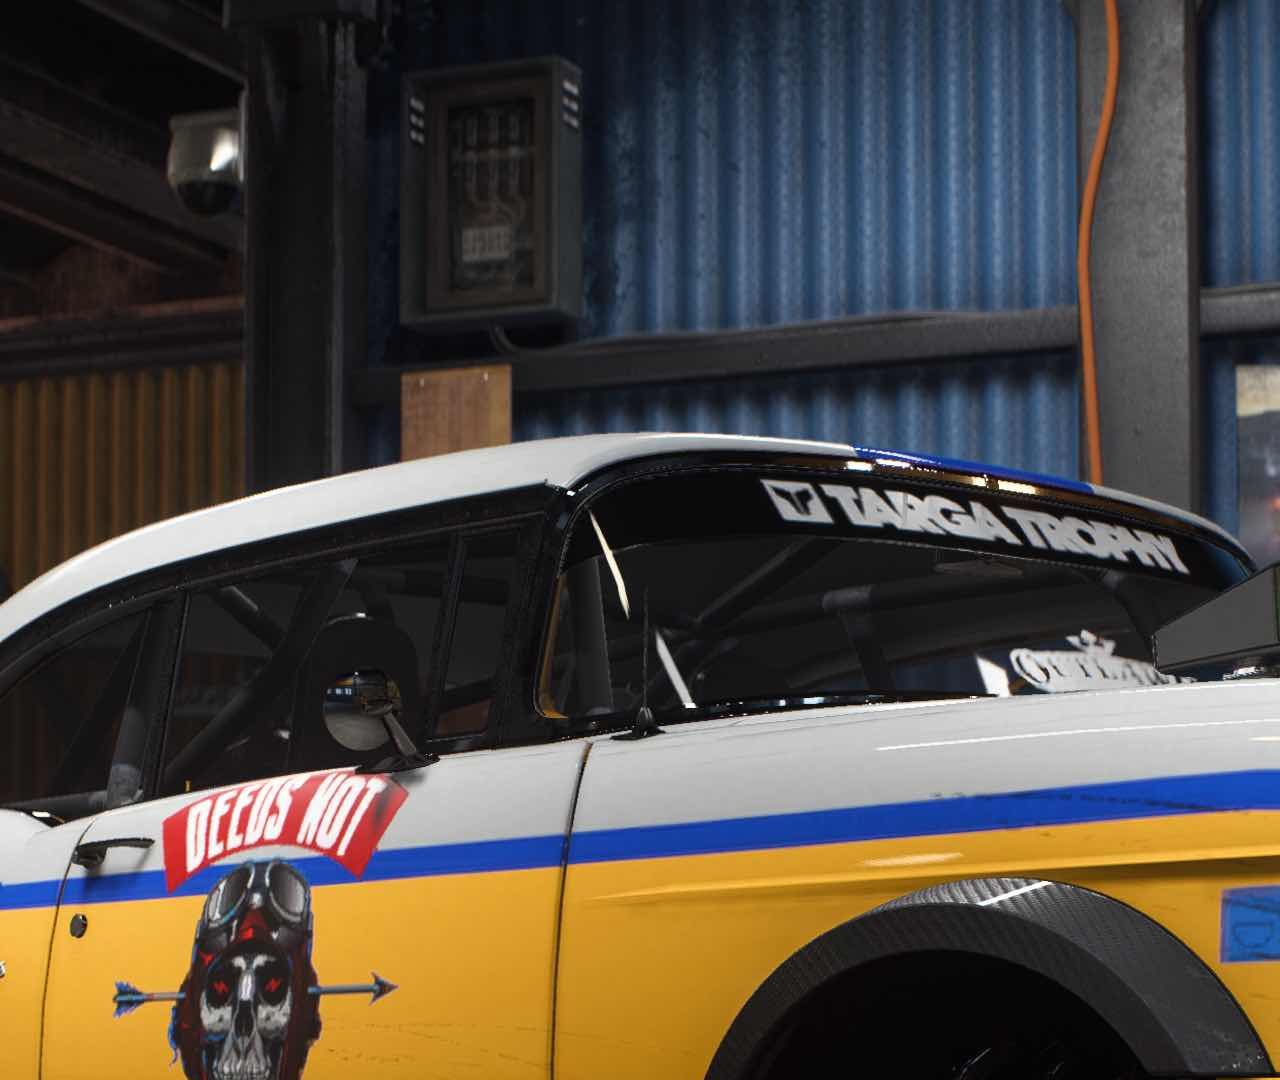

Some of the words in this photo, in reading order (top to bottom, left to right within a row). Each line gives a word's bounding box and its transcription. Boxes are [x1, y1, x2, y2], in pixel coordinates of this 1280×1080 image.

[818, 484, 1022, 545] TARGA
[999, 505, 1191, 577] TROPHY
[296, 773, 387, 857] NOT
